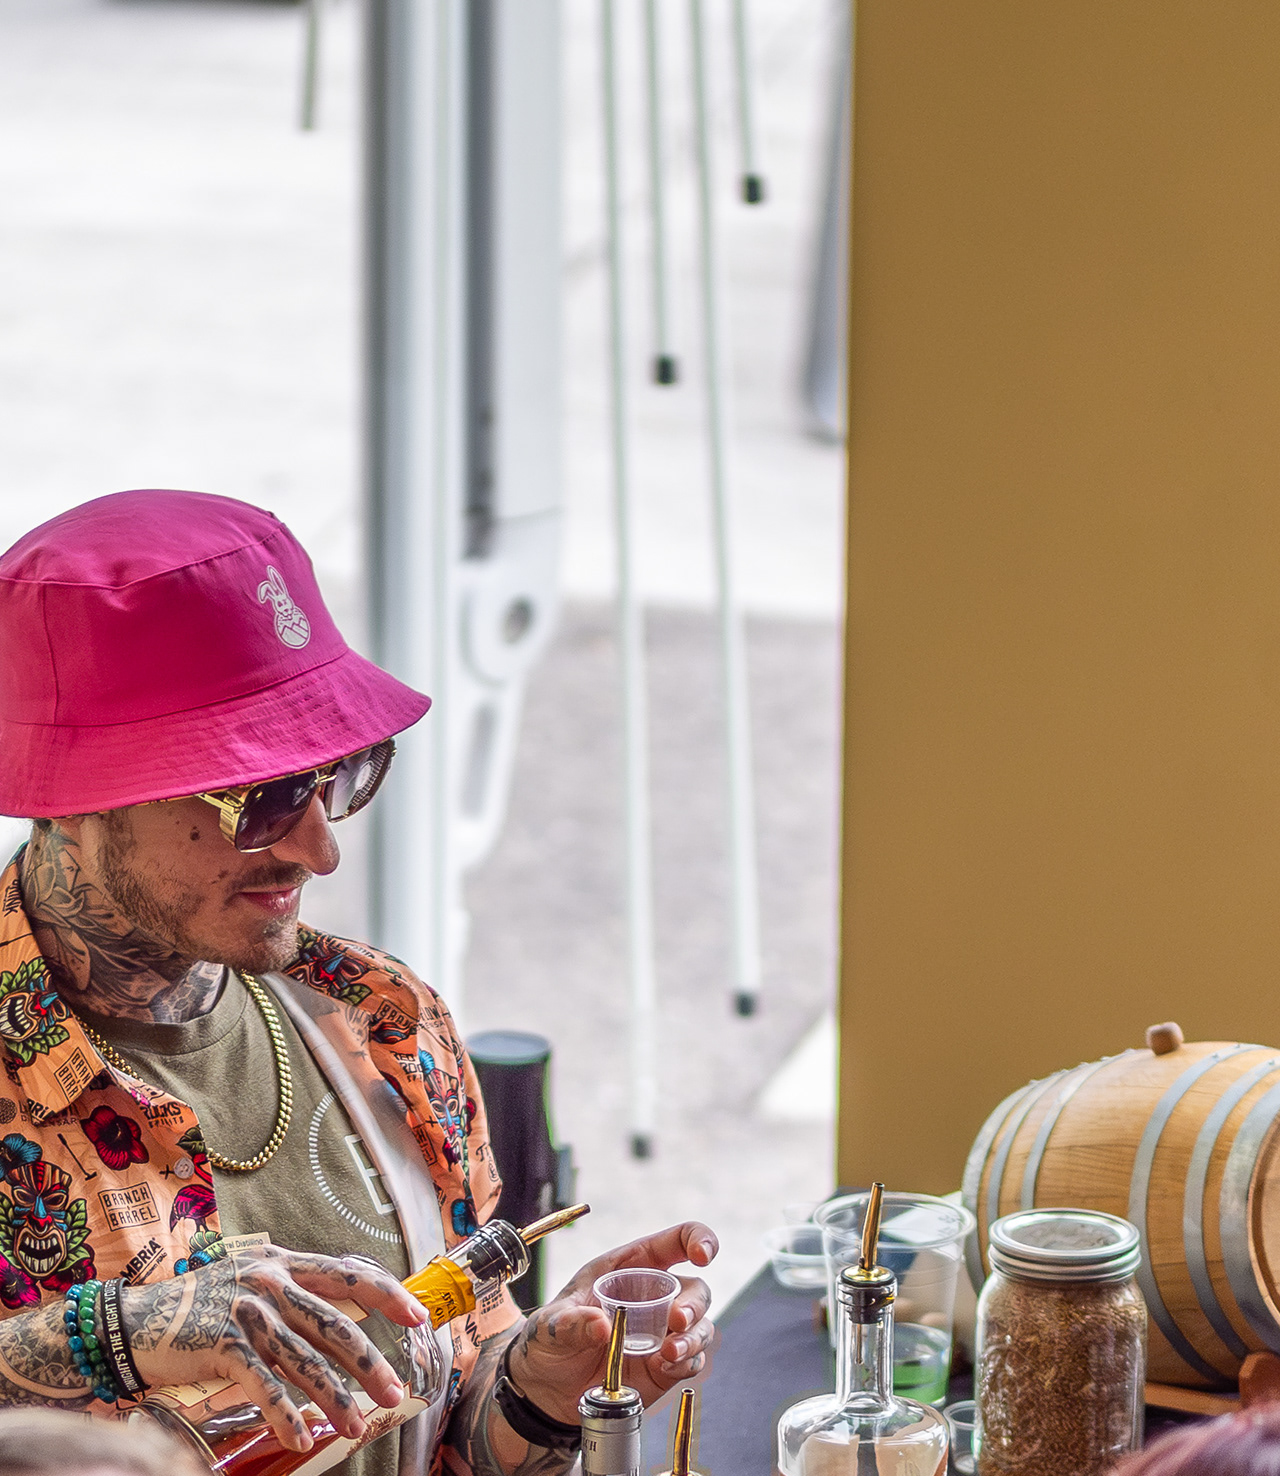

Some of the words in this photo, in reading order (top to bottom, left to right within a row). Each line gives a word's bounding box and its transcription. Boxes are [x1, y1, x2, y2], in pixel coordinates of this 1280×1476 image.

[71, 1056, 93, 1084] BRAN
[58, 1068, 79, 1099] BARR
[104, 1186, 151, 1207] BRANCH
[110, 1208, 156, 1227] BARREL
[104, 1303, 120, 1332] NIGHT
[109, 1331, 124, 1353] THE
